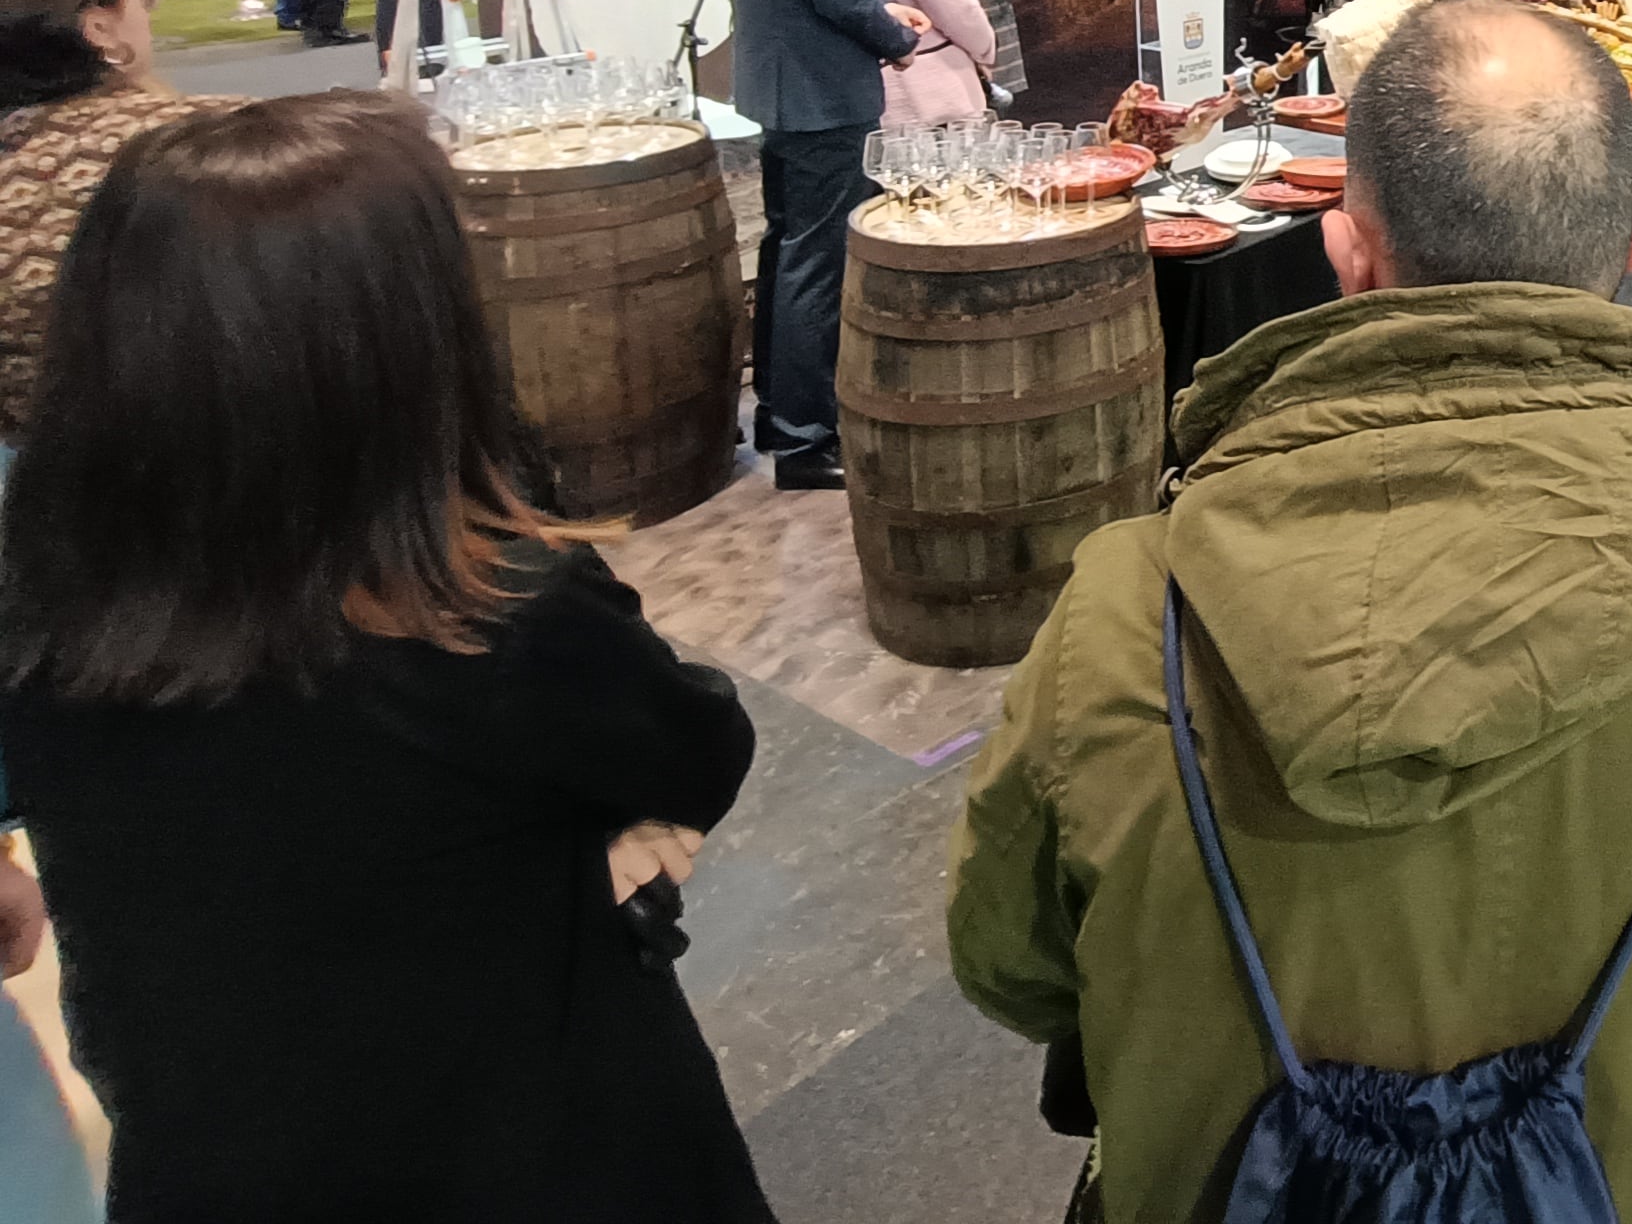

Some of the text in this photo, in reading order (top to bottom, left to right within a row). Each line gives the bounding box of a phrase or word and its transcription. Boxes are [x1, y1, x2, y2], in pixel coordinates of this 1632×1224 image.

[1177, 59, 1213, 75] Aranda
[1177, 71, 1213, 86] de Duero
